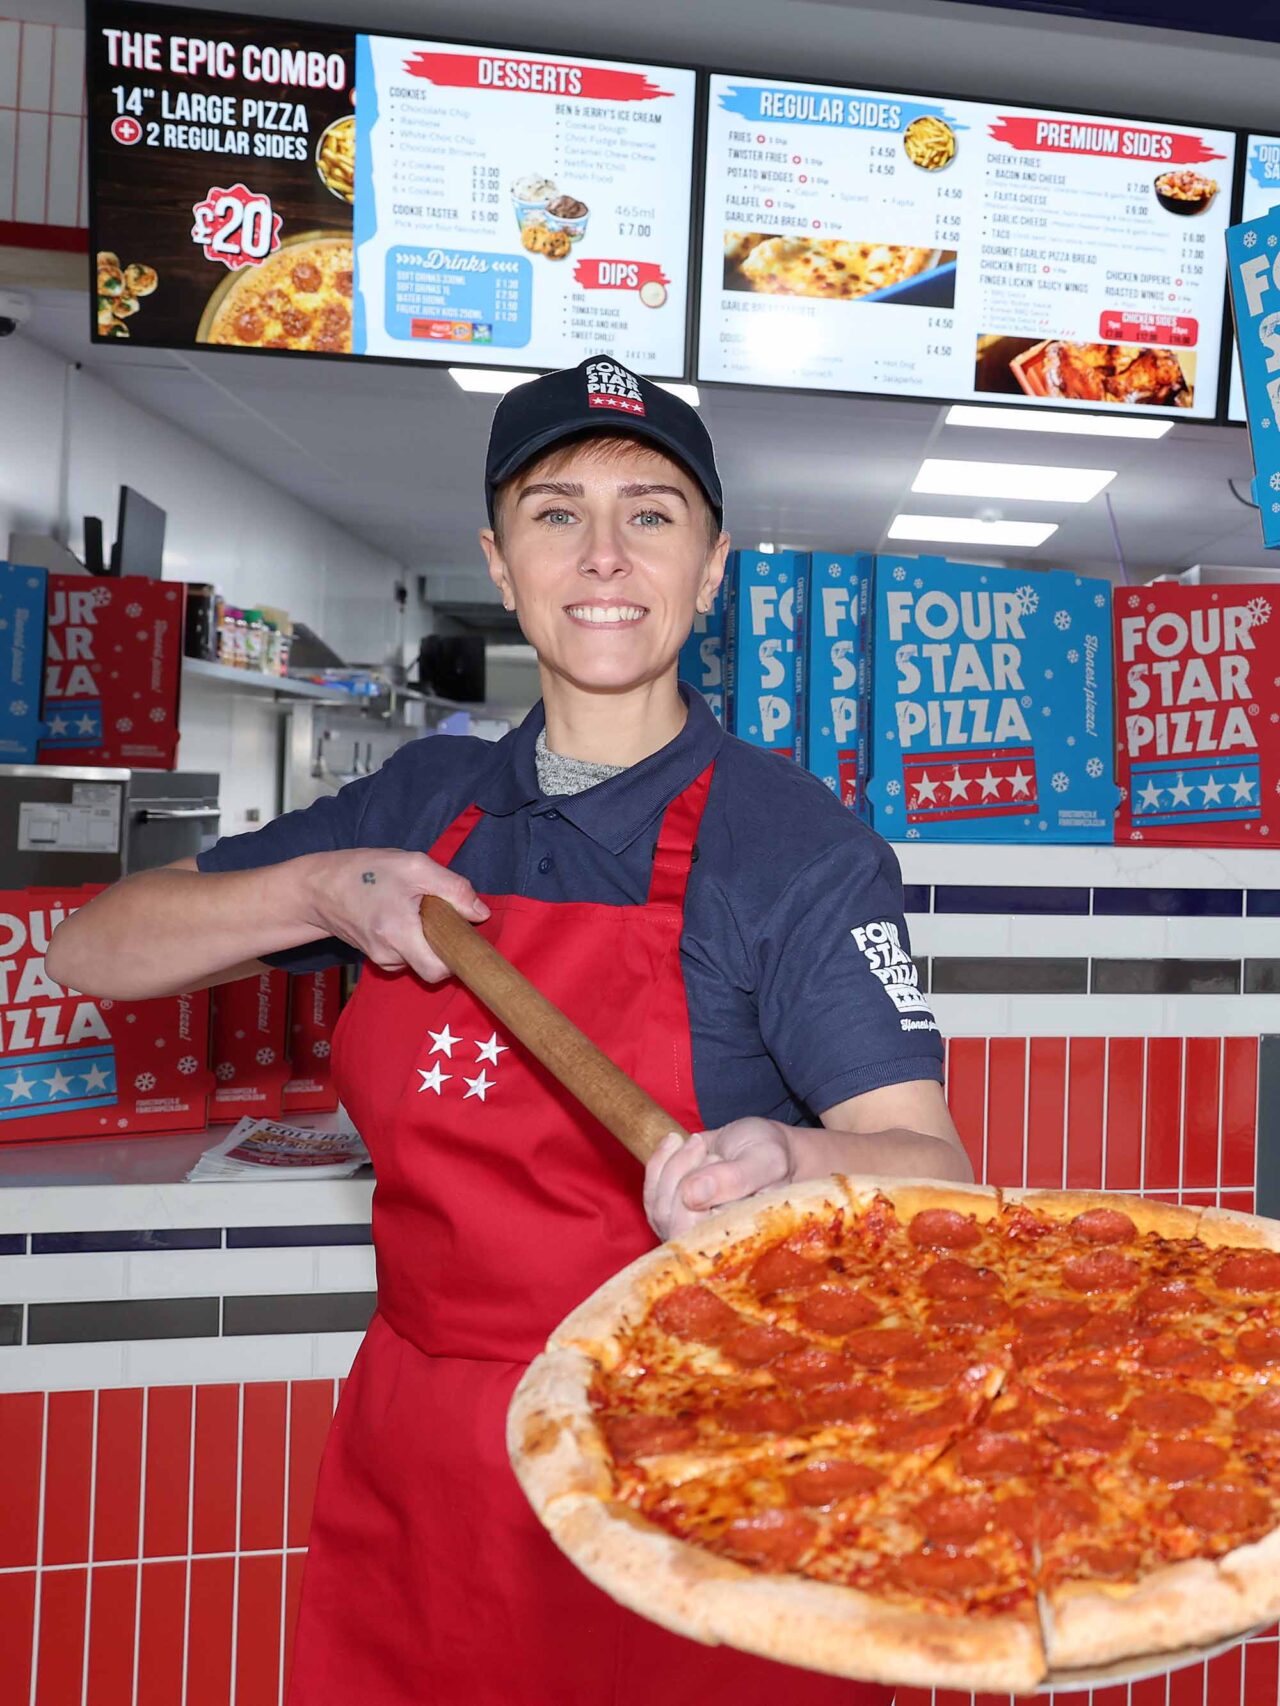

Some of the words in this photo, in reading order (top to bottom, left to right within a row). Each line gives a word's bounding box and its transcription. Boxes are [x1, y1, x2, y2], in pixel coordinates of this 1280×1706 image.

[102, 29, 163, 71] THE
[169, 36, 236, 79] EPIC
[242, 45, 346, 91] COMBO
[478, 58, 583, 95] DESSERTS
[389, 86, 427, 100] COOKIES
[111, 85, 155, 116] 14"
[161, 90, 237, 127] LARGE
[242, 98, 310, 133] PIZZA
[555, 104, 572, 115] BEN
[617, 109, 630, 121] ICE
[632, 111, 662, 123] CREAM
[760, 91, 844, 124] REGULAR
[847, 99, 902, 129] SIDES
[146, 123, 161, 147] 2
[164, 124, 250, 156] REGULAR
[254, 132, 308, 161] SIDES
[728, 130, 751, 143] FRIES
[1035, 121, 1119, 154] PREMIUM
[1122, 130, 1173, 159] SIDES
[728, 148, 763, 161] TWISTER
[765, 151, 788, 163] FRIES
[987, 153, 1017, 165] CHEEKY
[1019, 156, 1041, 168] FRIES
[1259, 145, 1280, 163] DID
[727, 167, 759, 179] POTATO
[761, 170, 794, 183] WEDGES
[995, 169, 1020, 179] BACON
[1022, 172, 1037, 181] AND
[1039, 173, 1066, 185] CHEESE
[725, 194, 760, 208] FALAFEL
[1019, 194, 1047, 206] CHEESE
[392, 204, 423, 217] COOKIE
[427, 206, 459, 219] TASTER
[724, 211, 754, 223] GARLIC
[755, 213, 779, 225] PIZZA
[781, 216, 808, 228] BREAD
[992, 213, 1018, 224] GARLIC
[1020, 216, 1047, 227] CHEESE
[192, 196, 274, 258] £20
[422, 250, 490, 272] Drinks
[981, 244, 1017, 256] GOURMET
[1020, 247, 1046, 259] GARLIC
[1048, 250, 1070, 262] PIZZA
[1072, 252, 1097, 264] BREAD
[598, 262, 639, 288] DIPS
[980, 259, 1013, 271] CHICKEN
[1016, 262, 1037, 274] BITES
[979, 274, 1006, 286] FINGER
[1037, 279, 1062, 291] SAUCY
[1064, 283, 1088, 293] WINGS
[1105, 270, 1138, 281] CHICKEN
[1140, 273, 1171, 285] DIPPERS
[1105, 286, 1139, 298] ROASTED
[1141, 290, 1164, 301] WINGS
[585, 362, 640, 386] FOUR
[587, 372, 641, 393] STAR
[587, 383, 643, 402] PIZZA
[886, 590, 1026, 641] FOUR
[1121, 606, 1256, 661] FOUR
[895, 643, 1025, 694] STAR
[1083, 634, 1099, 688] Honest
[1127, 655, 1254, 710] STAR
[870, 964, 918, 988] PIZZA
[0, 1001, 112, 1052] ZZA
